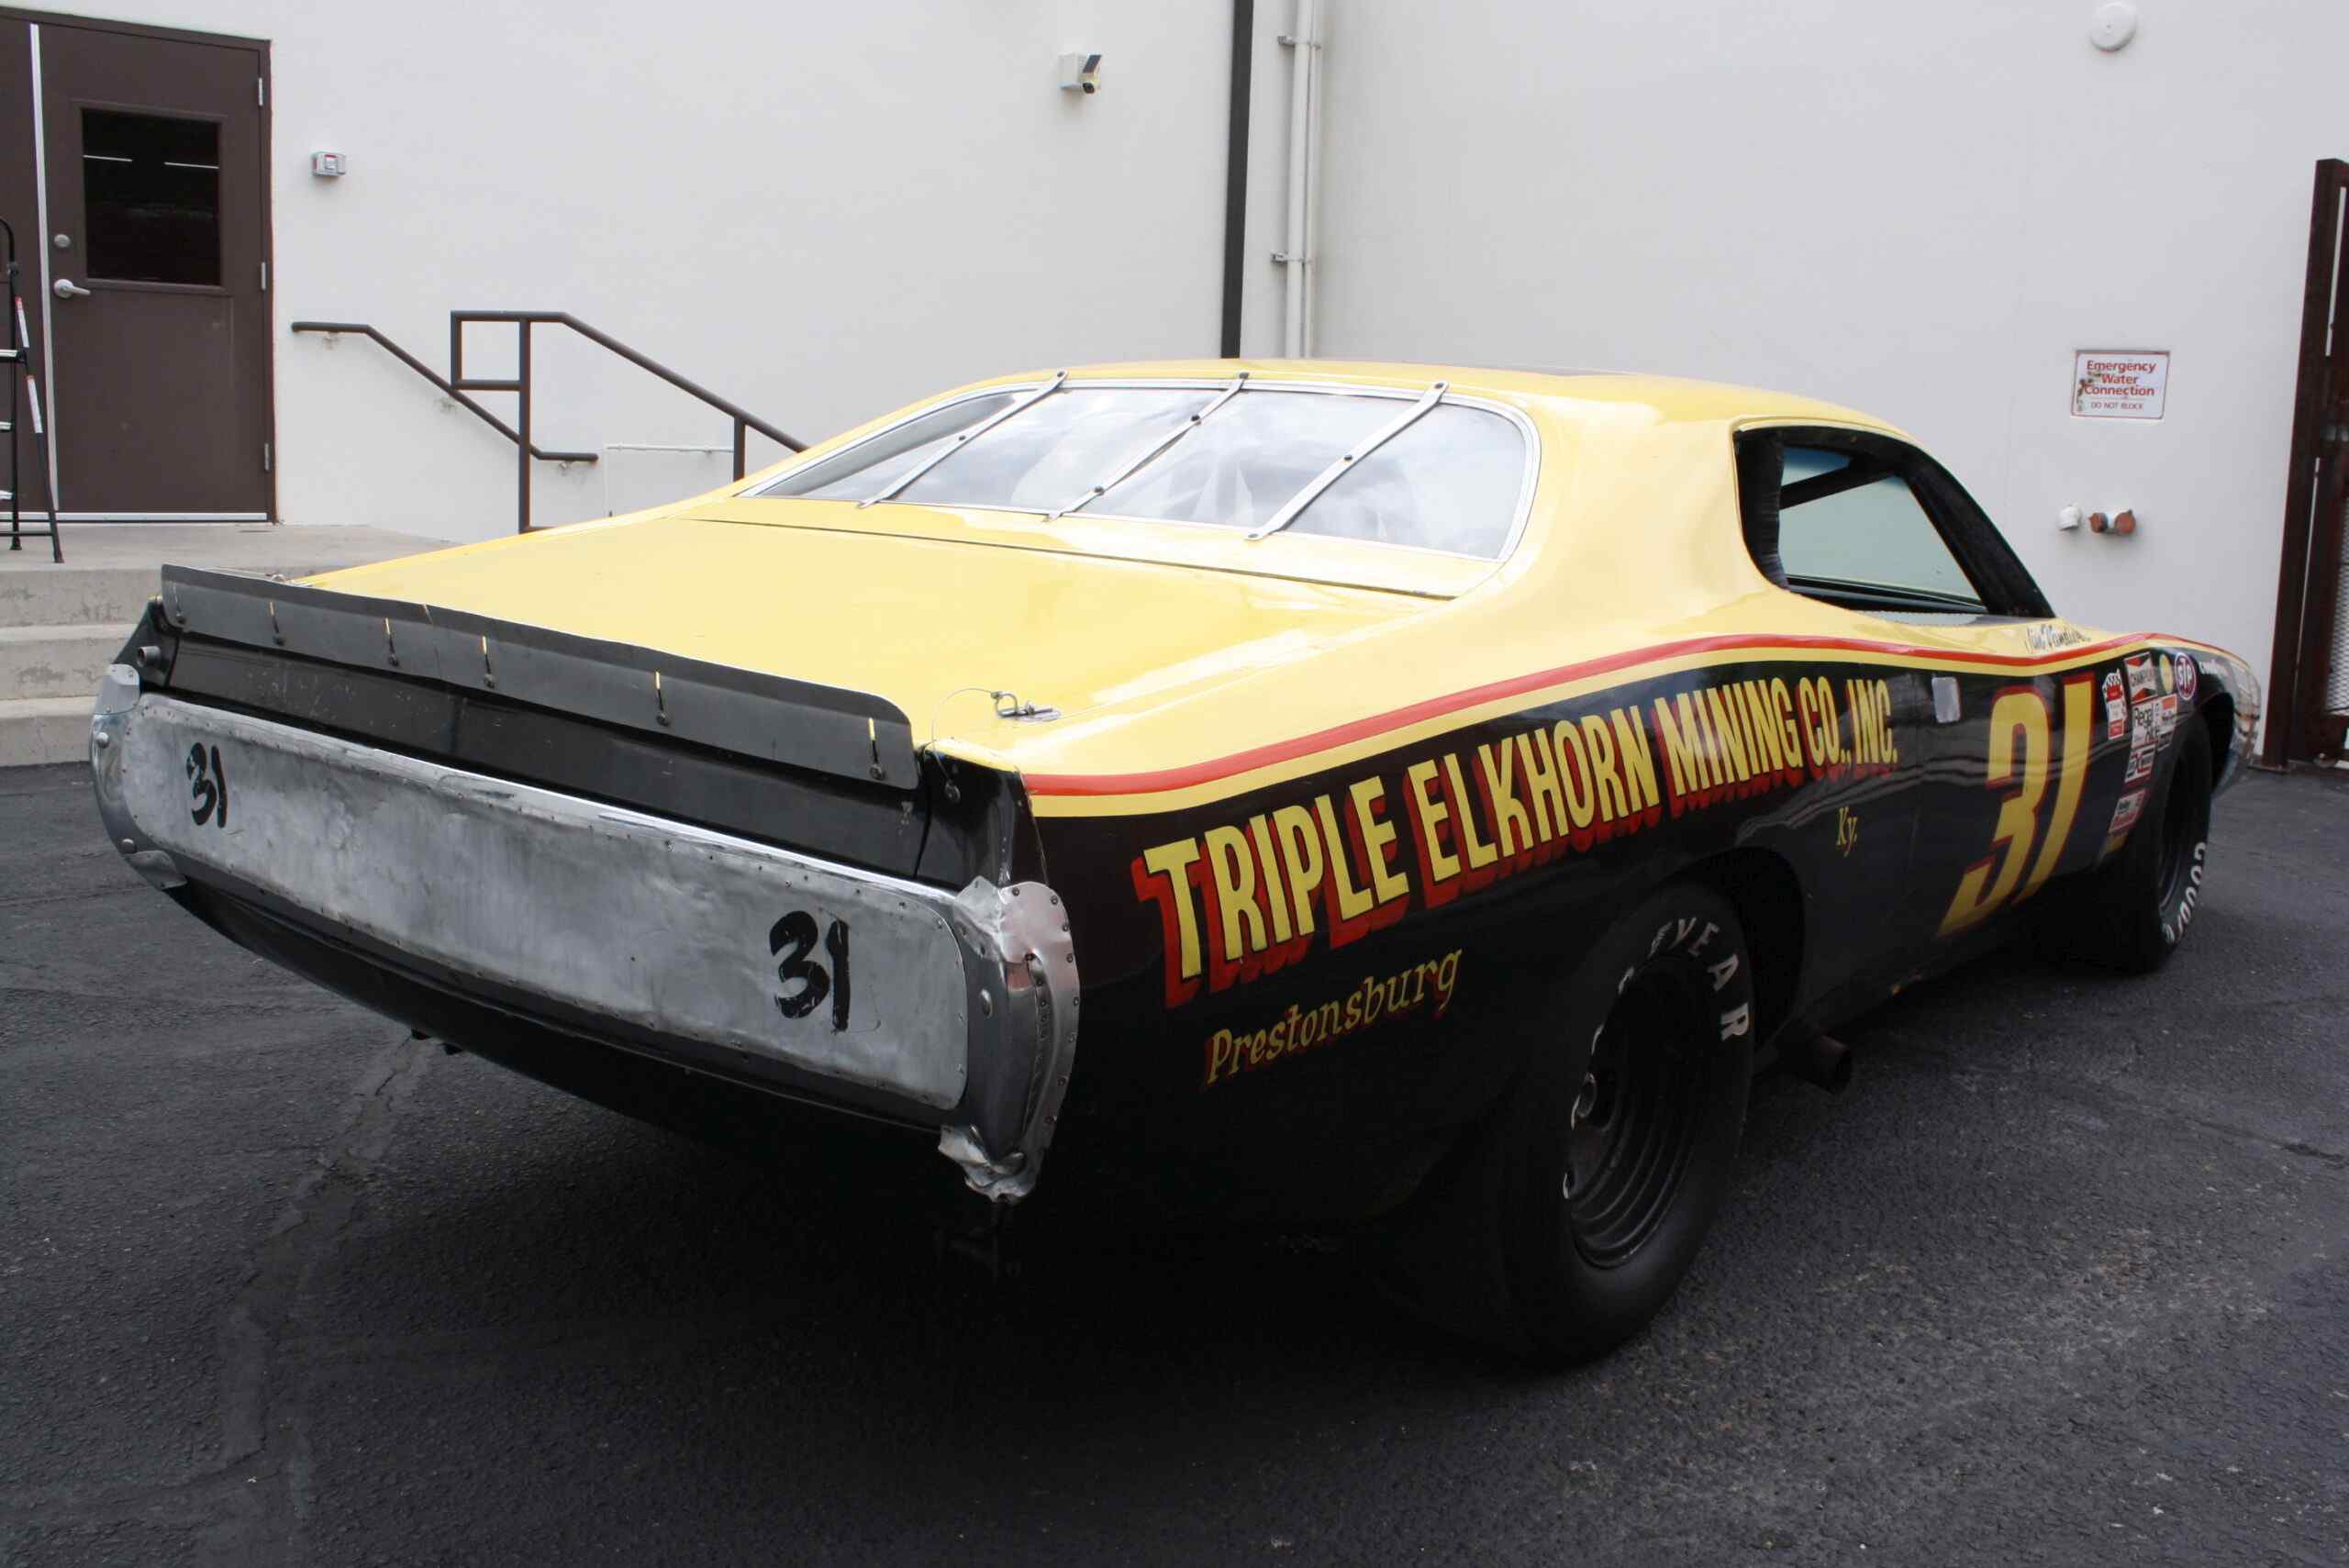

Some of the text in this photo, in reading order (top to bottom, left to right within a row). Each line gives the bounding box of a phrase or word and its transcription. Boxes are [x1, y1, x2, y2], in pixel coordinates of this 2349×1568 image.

[2084, 385, 2154, 396] Connection
[2087, 360, 2156, 373] Emergency
[2100, 373, 2138, 384] Water
[185, 742, 228, 828] 31
[1141, 775, 1410, 982] TRIPLE
[1407, 705, 1661, 884] ELKHORN
[1653, 676, 1804, 797] MINING
[1847, 679, 1898, 764] INC.
[1938, 681, 2093, 938] 31
[768, 909, 852, 1032] 31
[1208, 948, 1463, 1085] Prestonsburg
